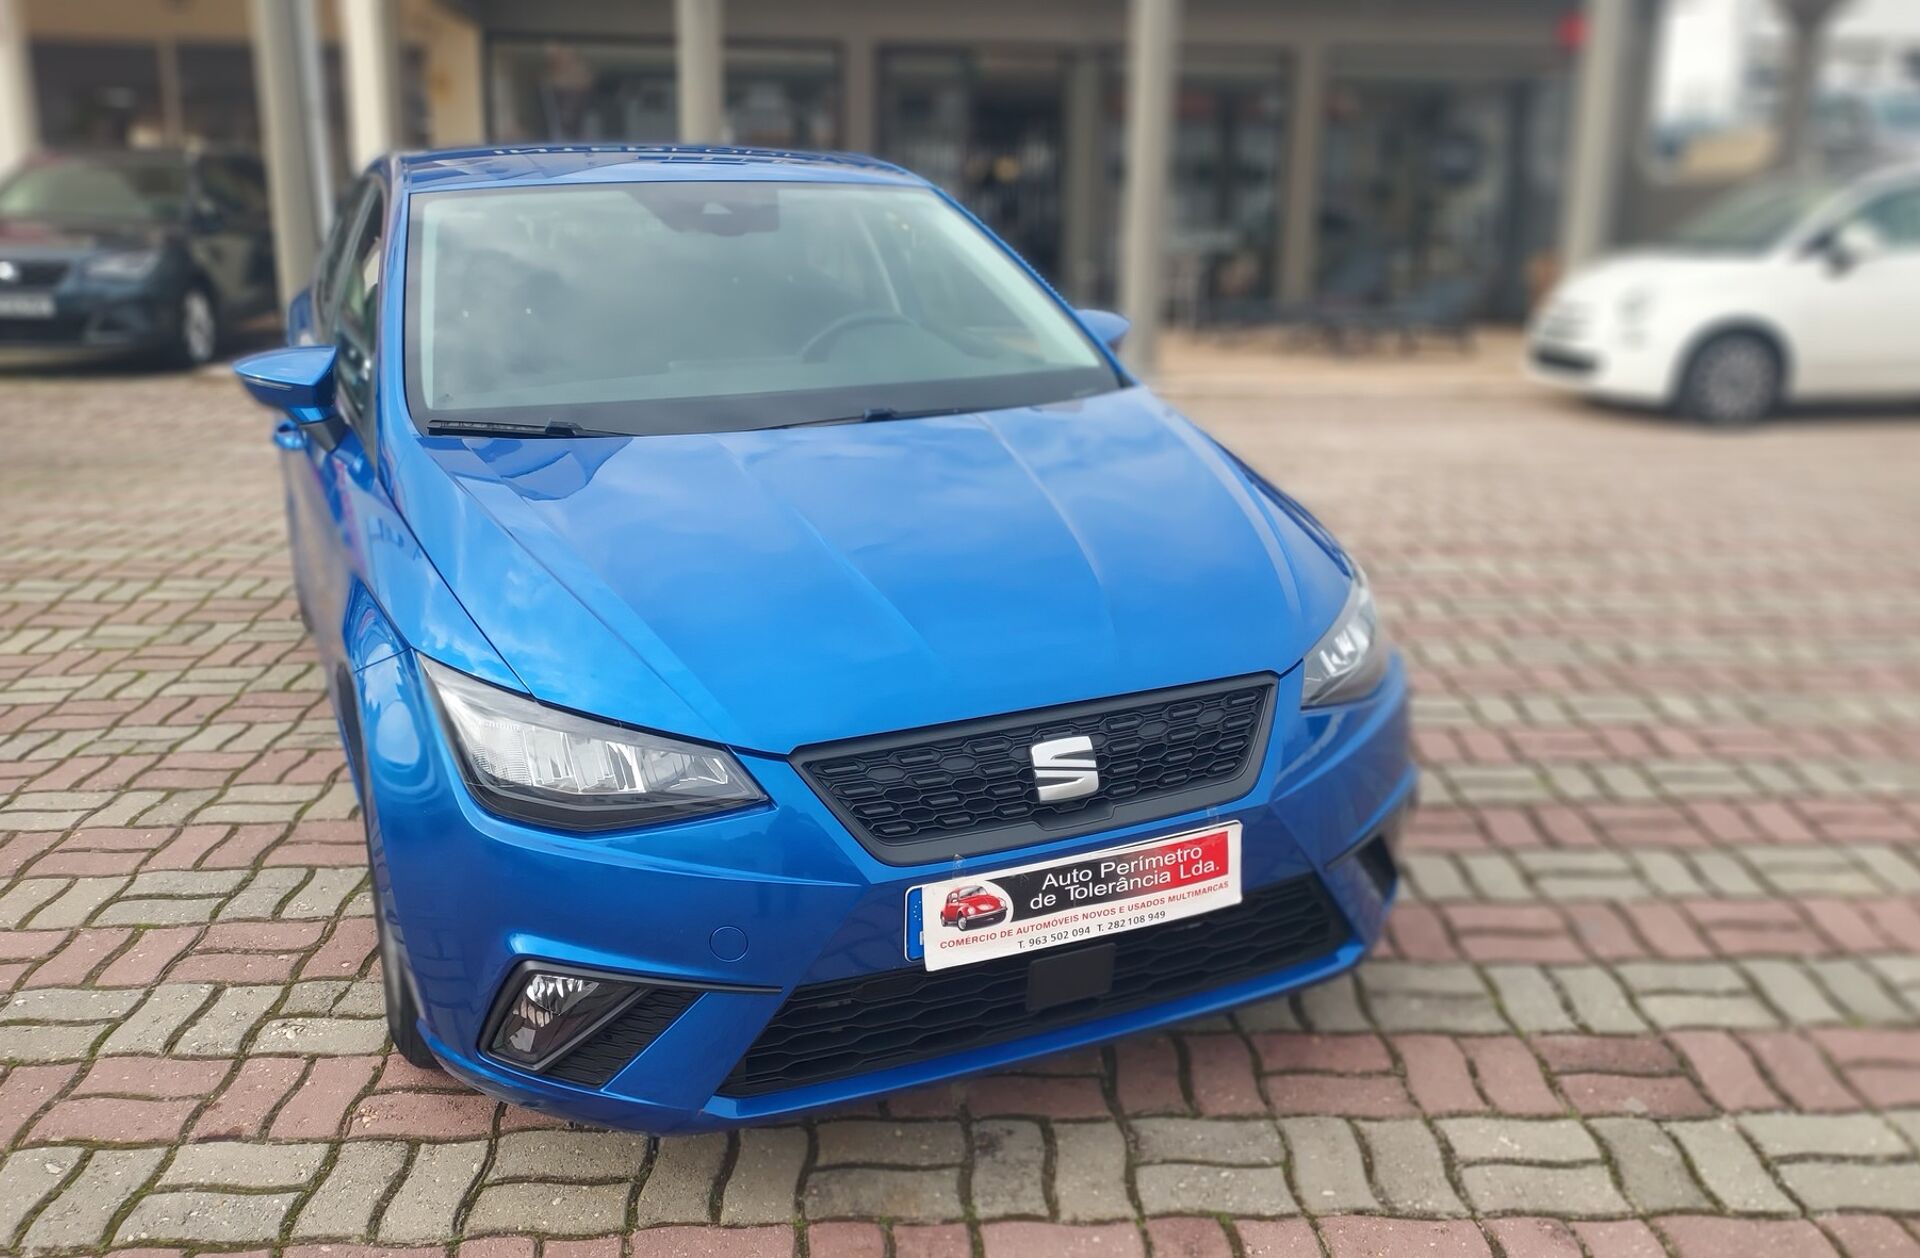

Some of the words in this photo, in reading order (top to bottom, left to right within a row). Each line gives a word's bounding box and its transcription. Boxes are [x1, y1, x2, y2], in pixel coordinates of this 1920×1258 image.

[1030, 893, 1056, 910] de
[1065, 870, 1171, 901] Tolerância
[1180, 859, 1220, 879] Lda.
[1042, 868, 1092, 890] Auto
[1101, 847, 1202, 878] Perímetro
[940, 932, 997, 949] COMÉRCIO
[1000, 929, 1013, 937] DE
[1016, 914, 1079, 935] AUTOMÓVEIS
[1082, 907, 1116, 920] NOVOS
[1119, 905, 1125, 914] E
[1127, 897, 1165, 912] USADOS
[1168, 881, 1229, 903] MULTIMARCAS
[1018, 941, 1026, 949] T.
[1029, 935, 1048, 946] 963
[1051, 931, 1069, 942] 502
[1072, 926, 1091, 937] 094
[1097, 924, 1104, 932] T.
[1107, 919, 1126, 930] 282
[1129, 915, 1146, 926] 108
[1148, 911, 1166, 921] 949
